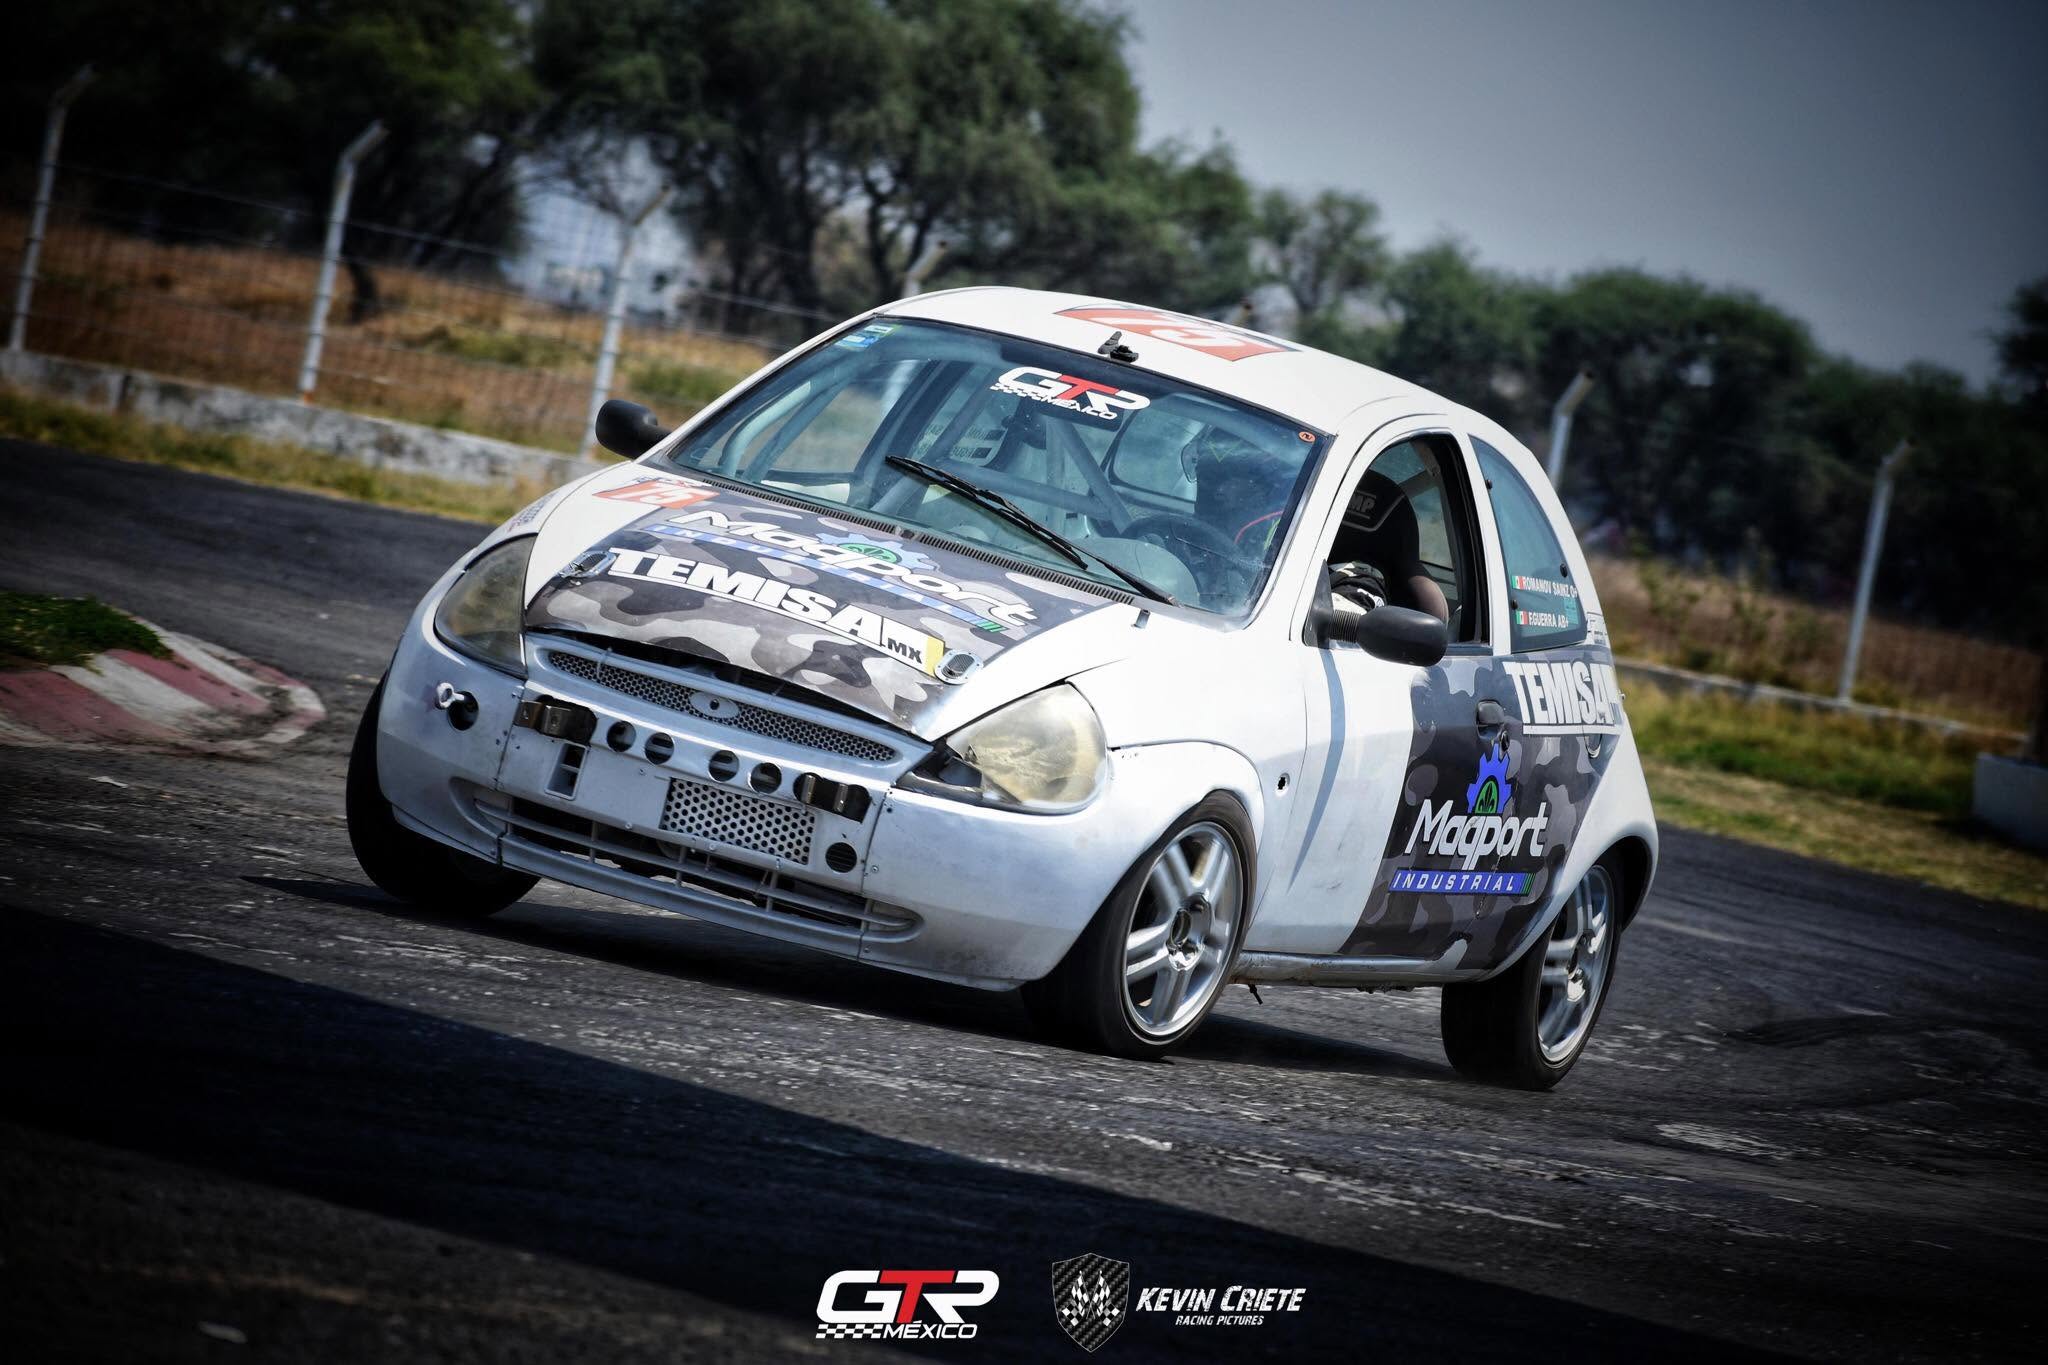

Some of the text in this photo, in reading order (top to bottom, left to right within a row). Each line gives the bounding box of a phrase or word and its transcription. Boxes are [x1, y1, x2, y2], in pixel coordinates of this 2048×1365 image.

[998, 366, 1151, 413] GTR
[1523, 575, 1552, 594] ROMANOV
[1502, 661, 1615, 725] TEMISA
[1393, 872, 1515, 891] INDUSTRIAL
